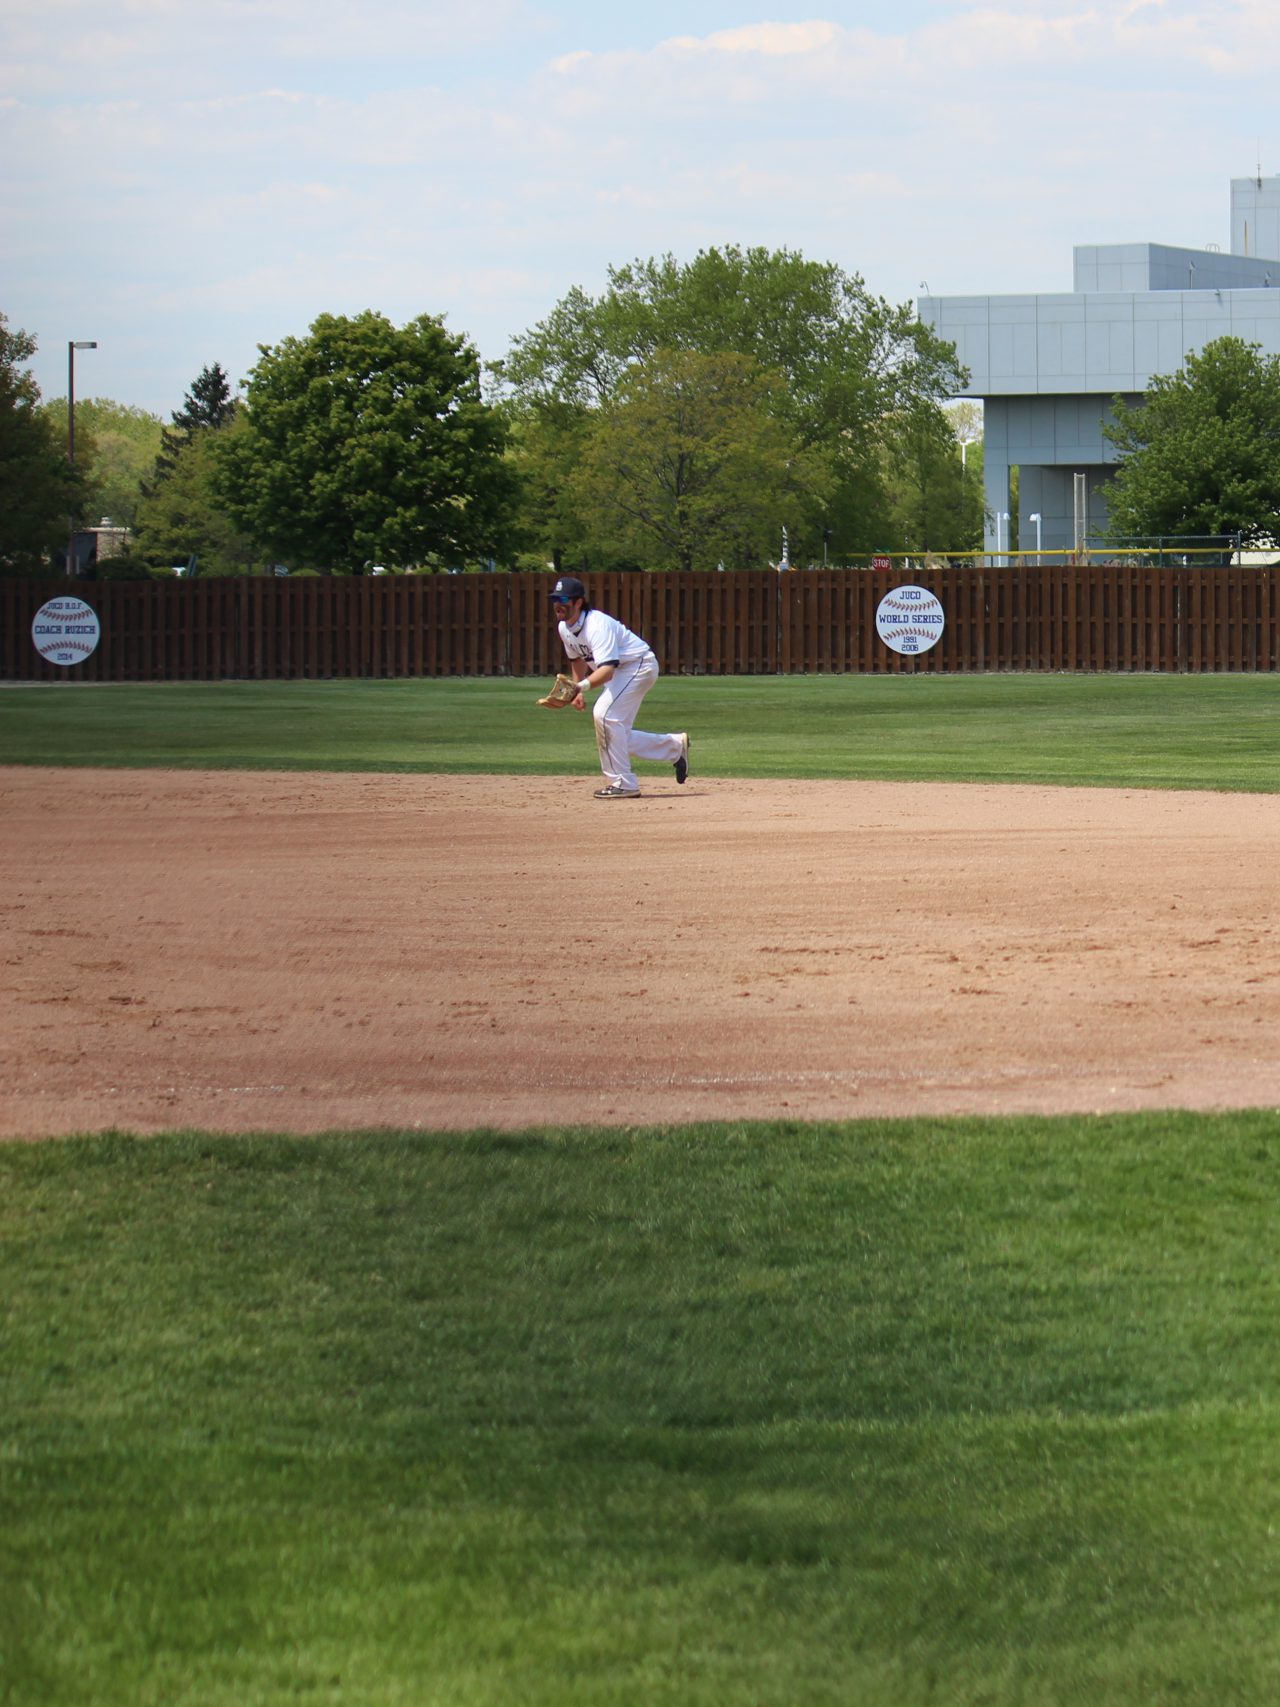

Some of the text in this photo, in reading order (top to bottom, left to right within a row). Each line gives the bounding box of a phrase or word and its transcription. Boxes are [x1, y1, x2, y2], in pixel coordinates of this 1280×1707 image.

[873, 558, 890, 568] STOP
[900, 591, 921, 600] JUCO
[879, 614, 943, 623] WORLD SERIES
[34, 625, 62, 634] COACH
